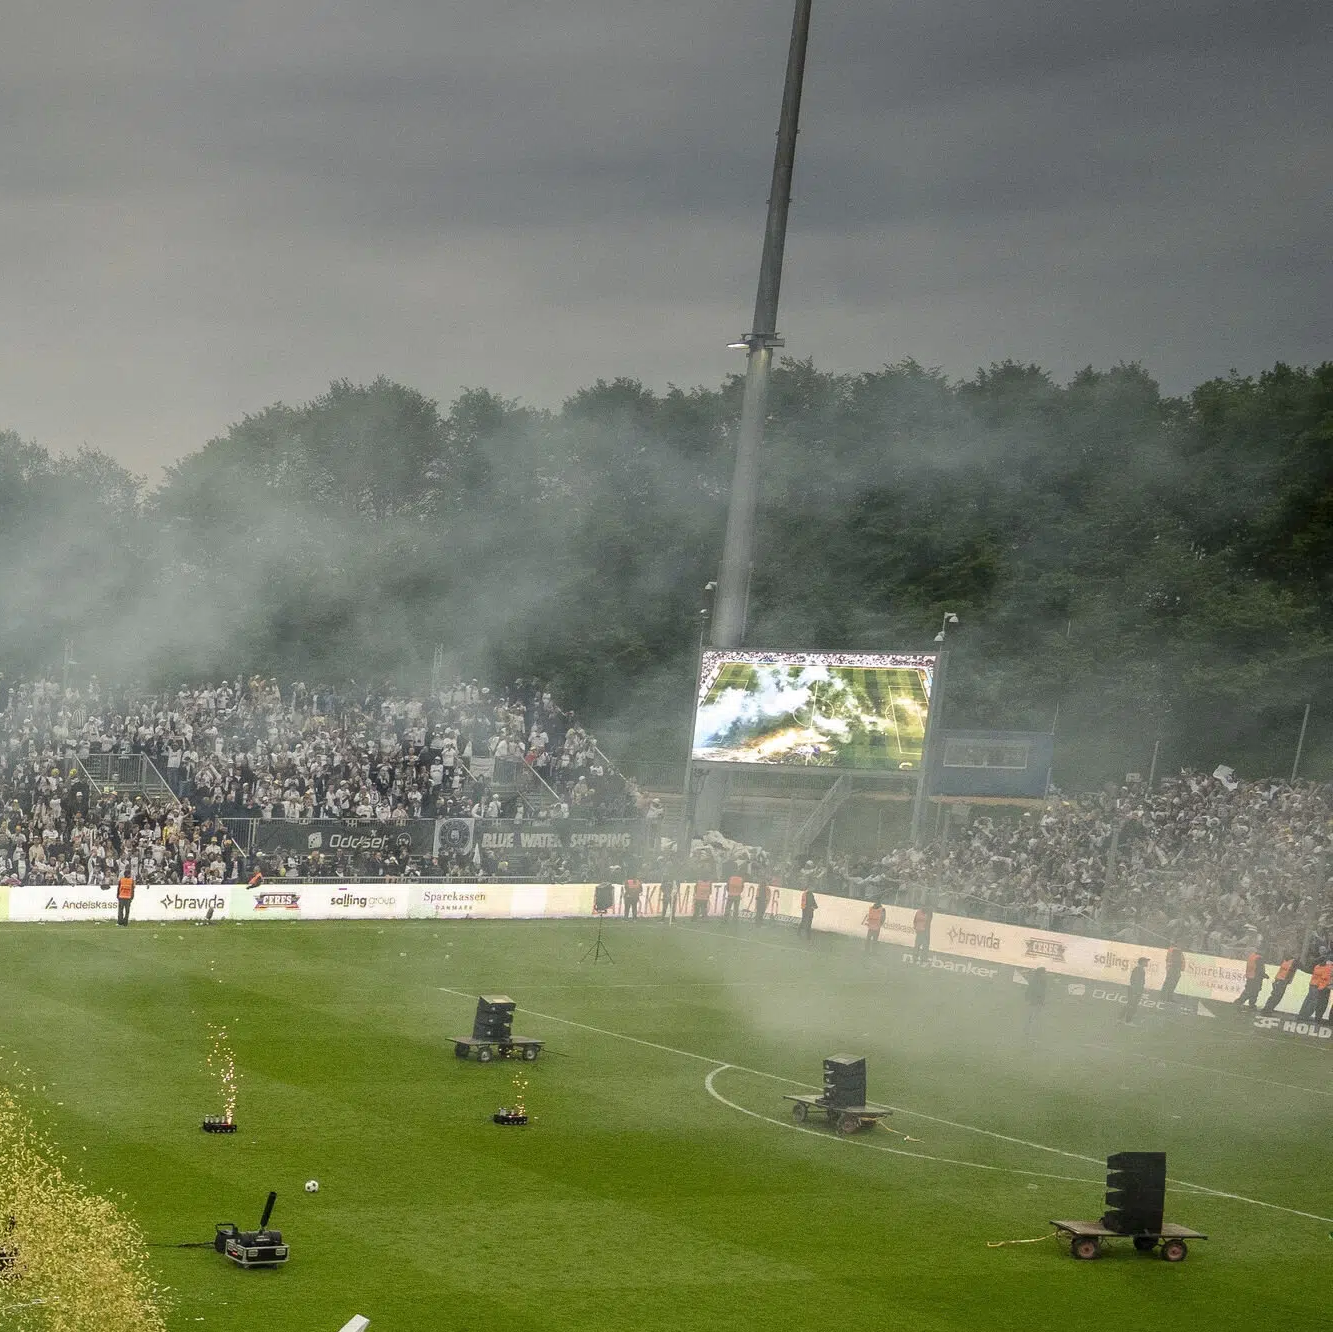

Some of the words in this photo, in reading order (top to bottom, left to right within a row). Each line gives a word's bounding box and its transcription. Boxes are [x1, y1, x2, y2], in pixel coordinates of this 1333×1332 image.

[483, 832, 513, 849] BLUE
[62, 899, 118, 910] Andelskass
[175, 895, 225, 910] bravida
[262, 895, 292, 906] CERES
[331, 893, 367, 908] salling
[368, 896, 396, 907] group
[423, 890, 486, 905] Sparekassen
[958, 928, 1000, 950] bravida
[1093, 951, 1129, 971] salling
[1283, 1020, 1332, 1039] HOLD
